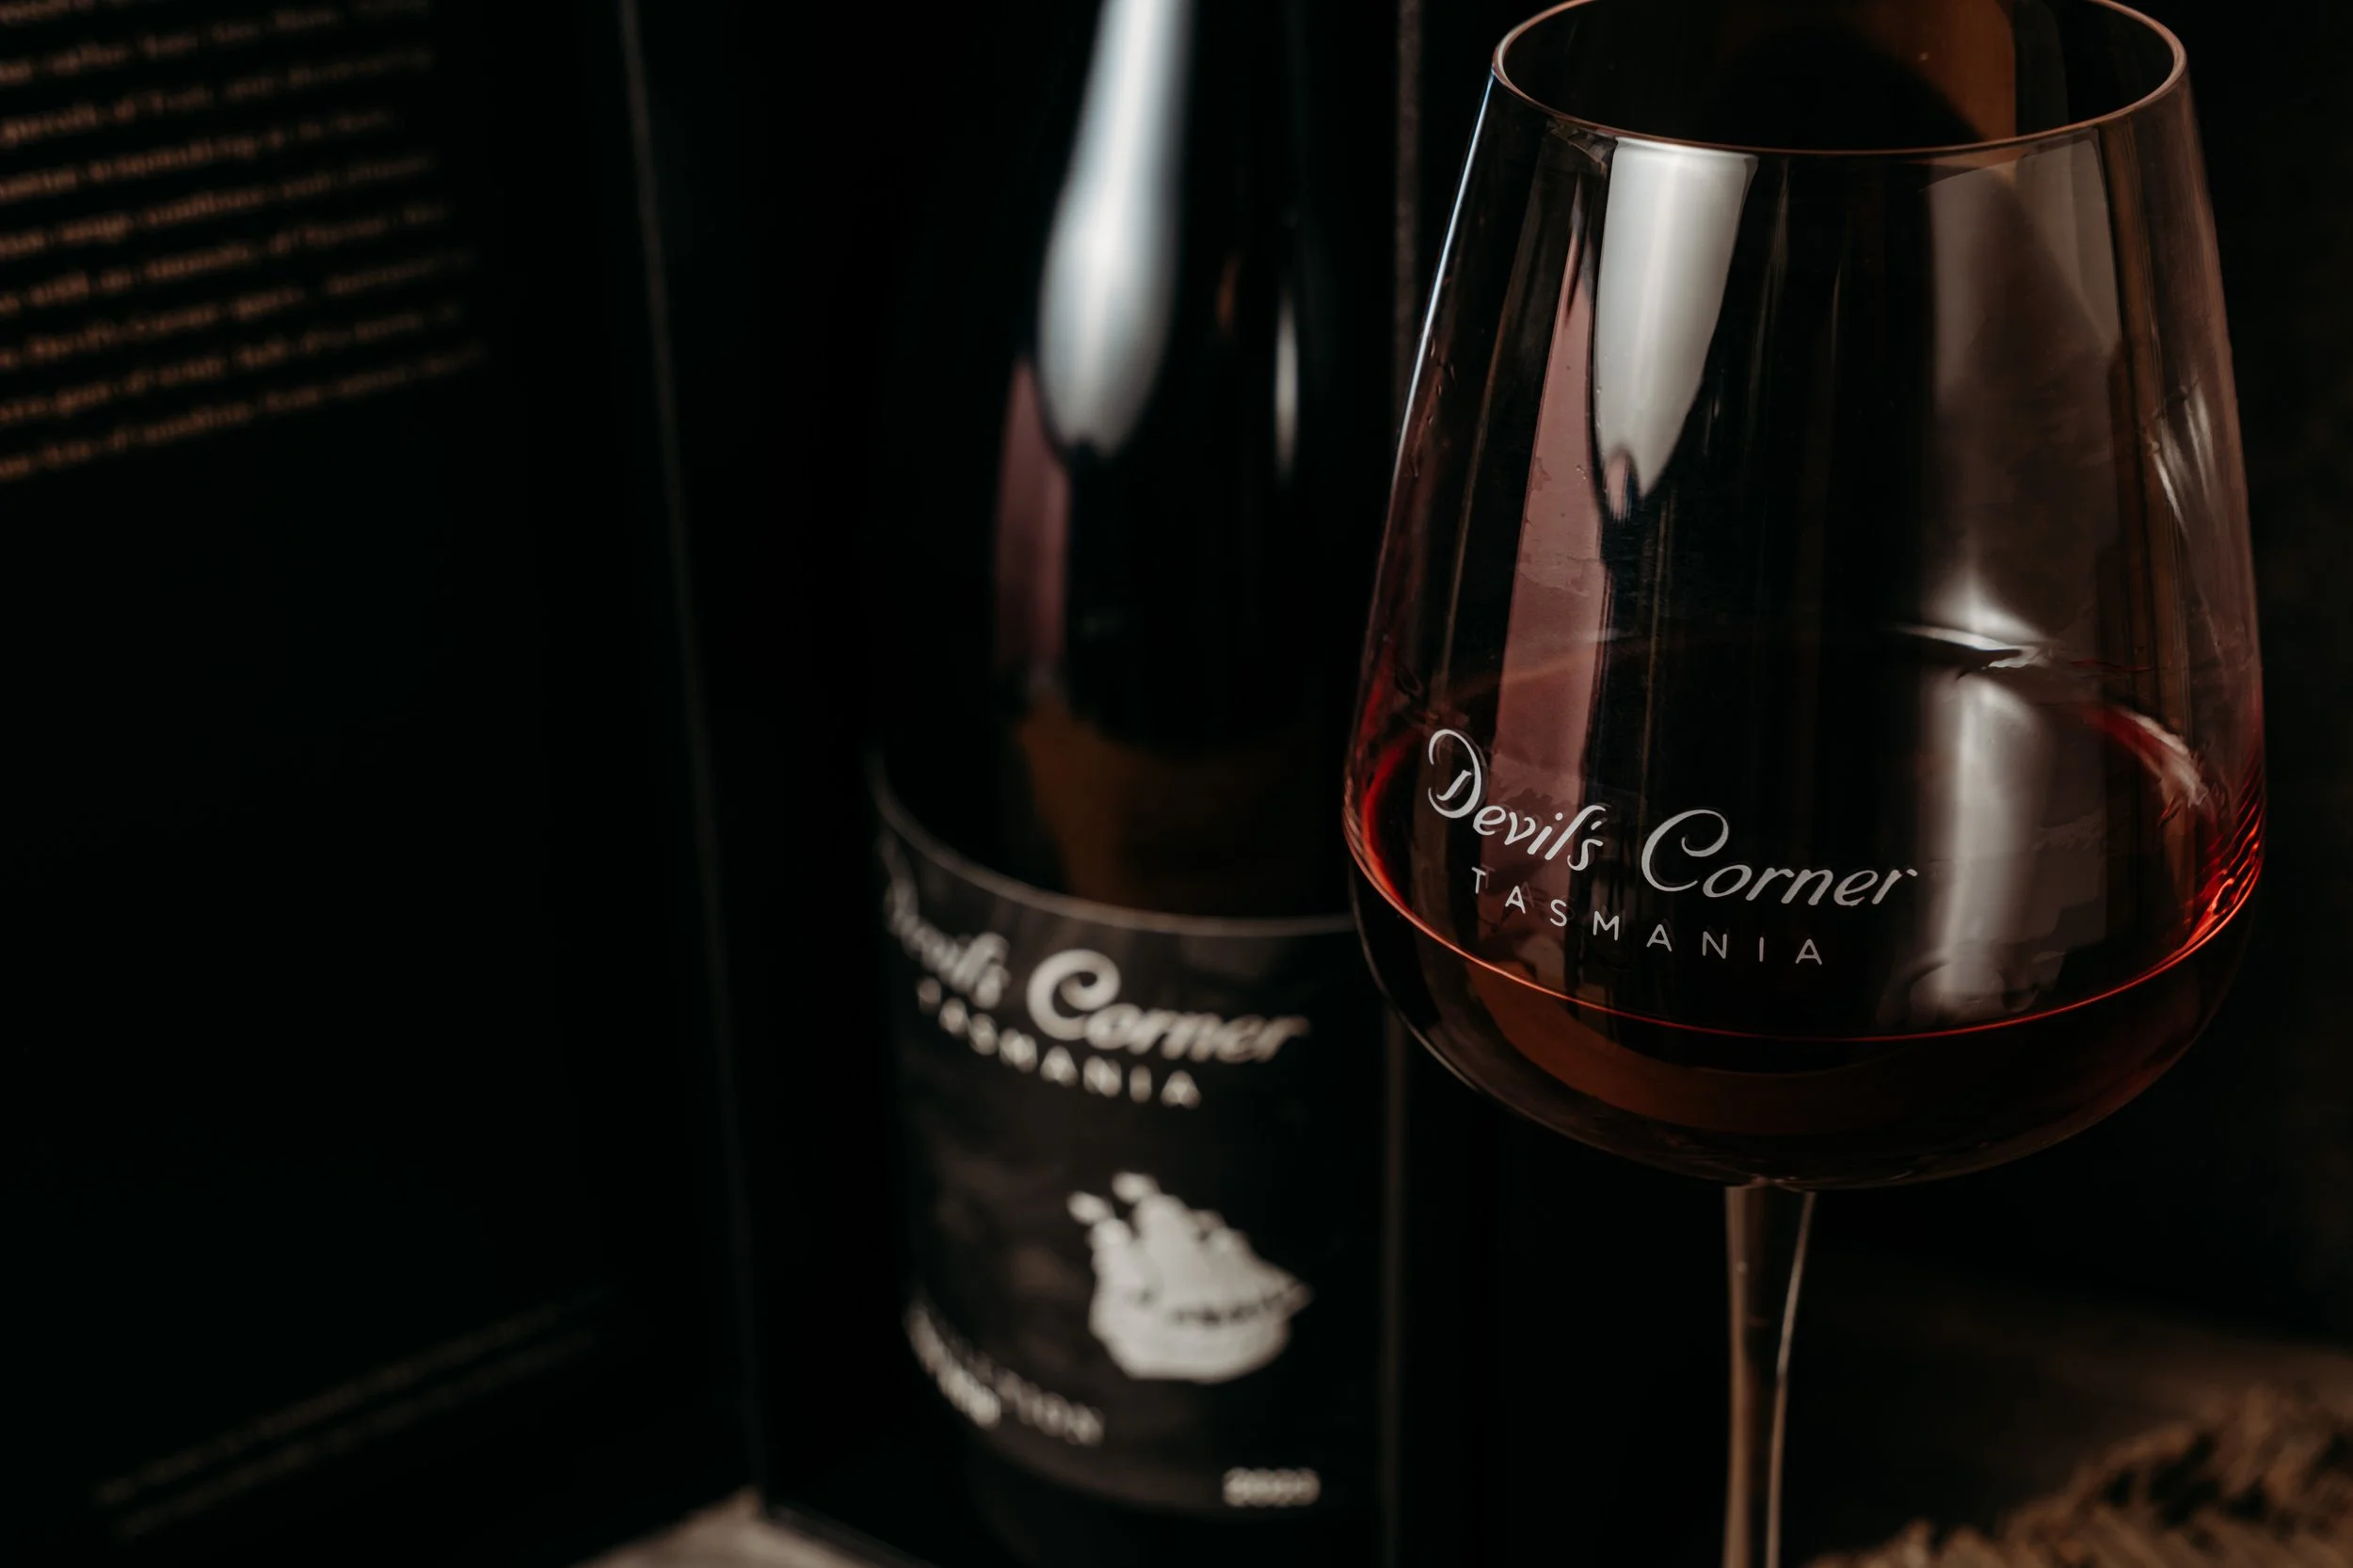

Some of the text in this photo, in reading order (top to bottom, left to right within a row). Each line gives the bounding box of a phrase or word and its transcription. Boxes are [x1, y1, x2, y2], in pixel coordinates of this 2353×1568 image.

[1428, 728, 1918, 906] Devil's Corner
[1471, 867, 1822, 967] TASMANIA
[1027, 949, 1309, 1064] Corner
